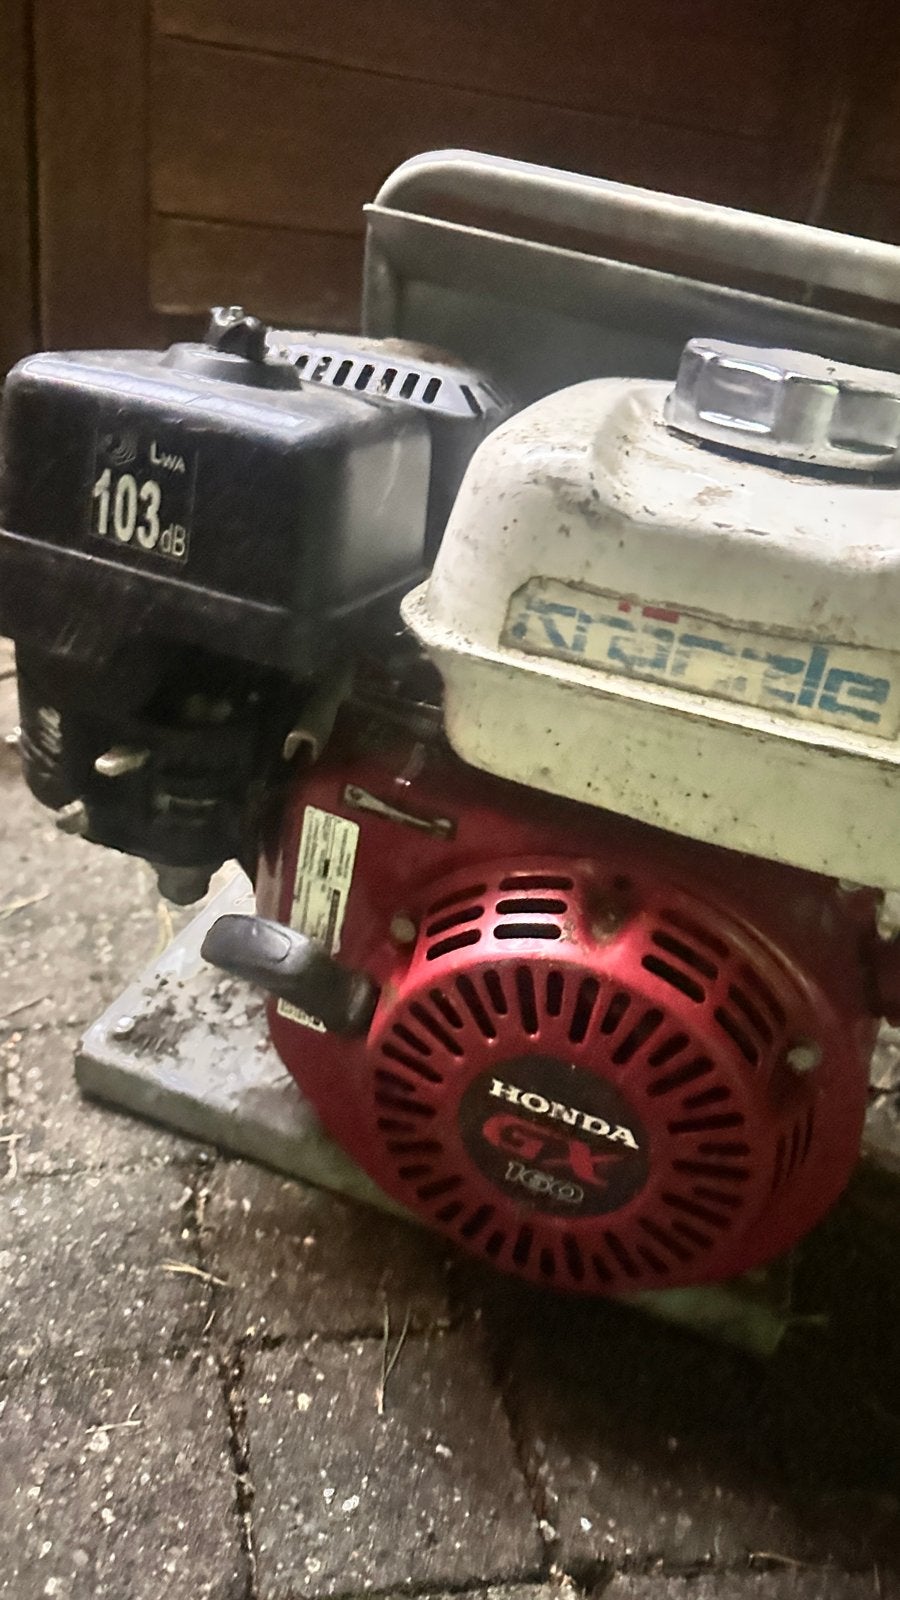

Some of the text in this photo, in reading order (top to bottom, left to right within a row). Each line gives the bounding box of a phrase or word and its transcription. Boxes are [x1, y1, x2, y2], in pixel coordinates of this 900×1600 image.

[92, 467, 161, 549] 103
[482, 1112, 627, 1188] GX
[488, 1077, 640, 1150] HONDA
